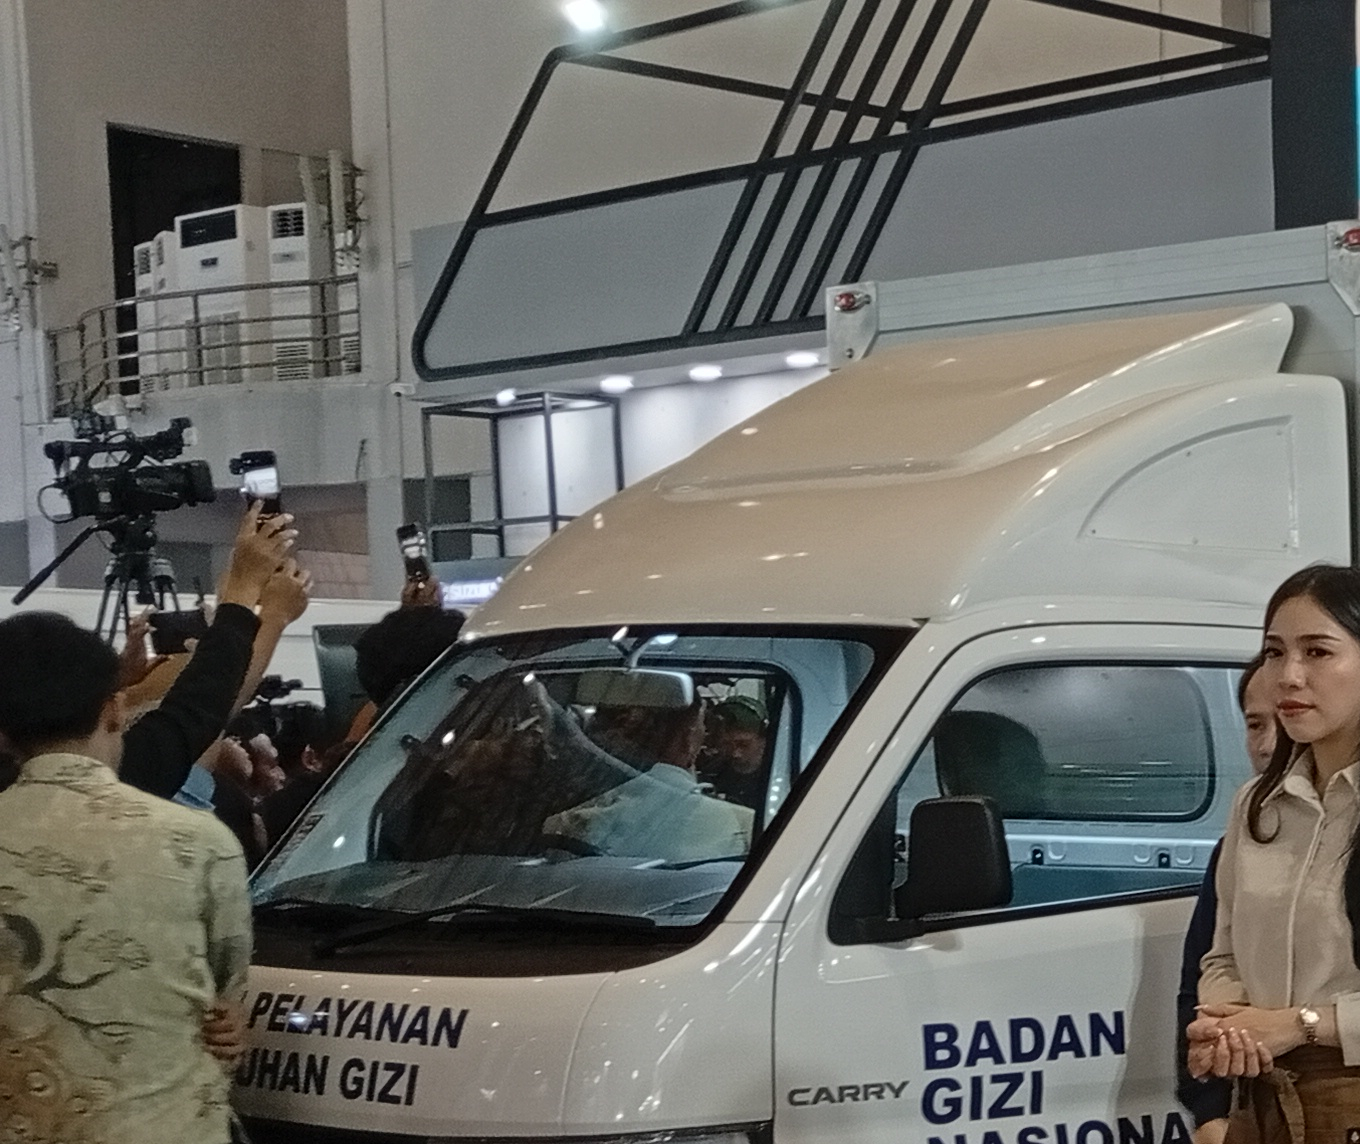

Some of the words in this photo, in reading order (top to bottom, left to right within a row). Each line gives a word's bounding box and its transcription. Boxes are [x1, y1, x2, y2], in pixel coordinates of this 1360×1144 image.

[247, 991, 470, 1049] PELAYANAN
[921, 1010, 1126, 1071] BADAN
[340, 1057, 420, 1106] GIZI
[787, 1081, 909, 1107] CARRY
[920, 1070, 1044, 1125] GIZI
